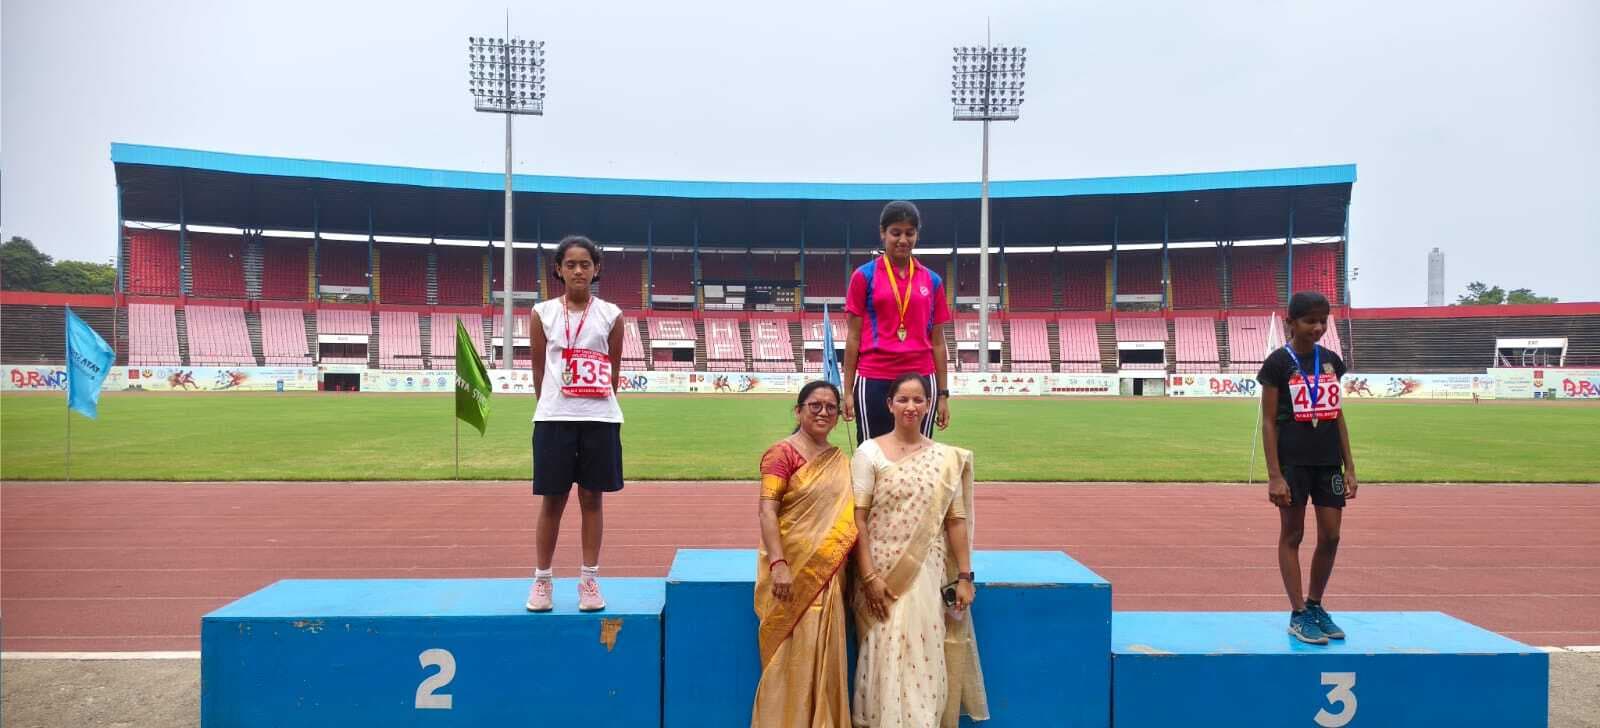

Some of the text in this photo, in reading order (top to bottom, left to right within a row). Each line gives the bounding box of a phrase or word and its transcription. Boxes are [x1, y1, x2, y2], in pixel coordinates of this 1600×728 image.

[565, 359, 612, 386] 435
[616, 374, 648, 391] RAND
[1294, 384, 1340, 409] 428
[415, 648, 457, 709] 2
[1313, 671, 1358, 728] 3
